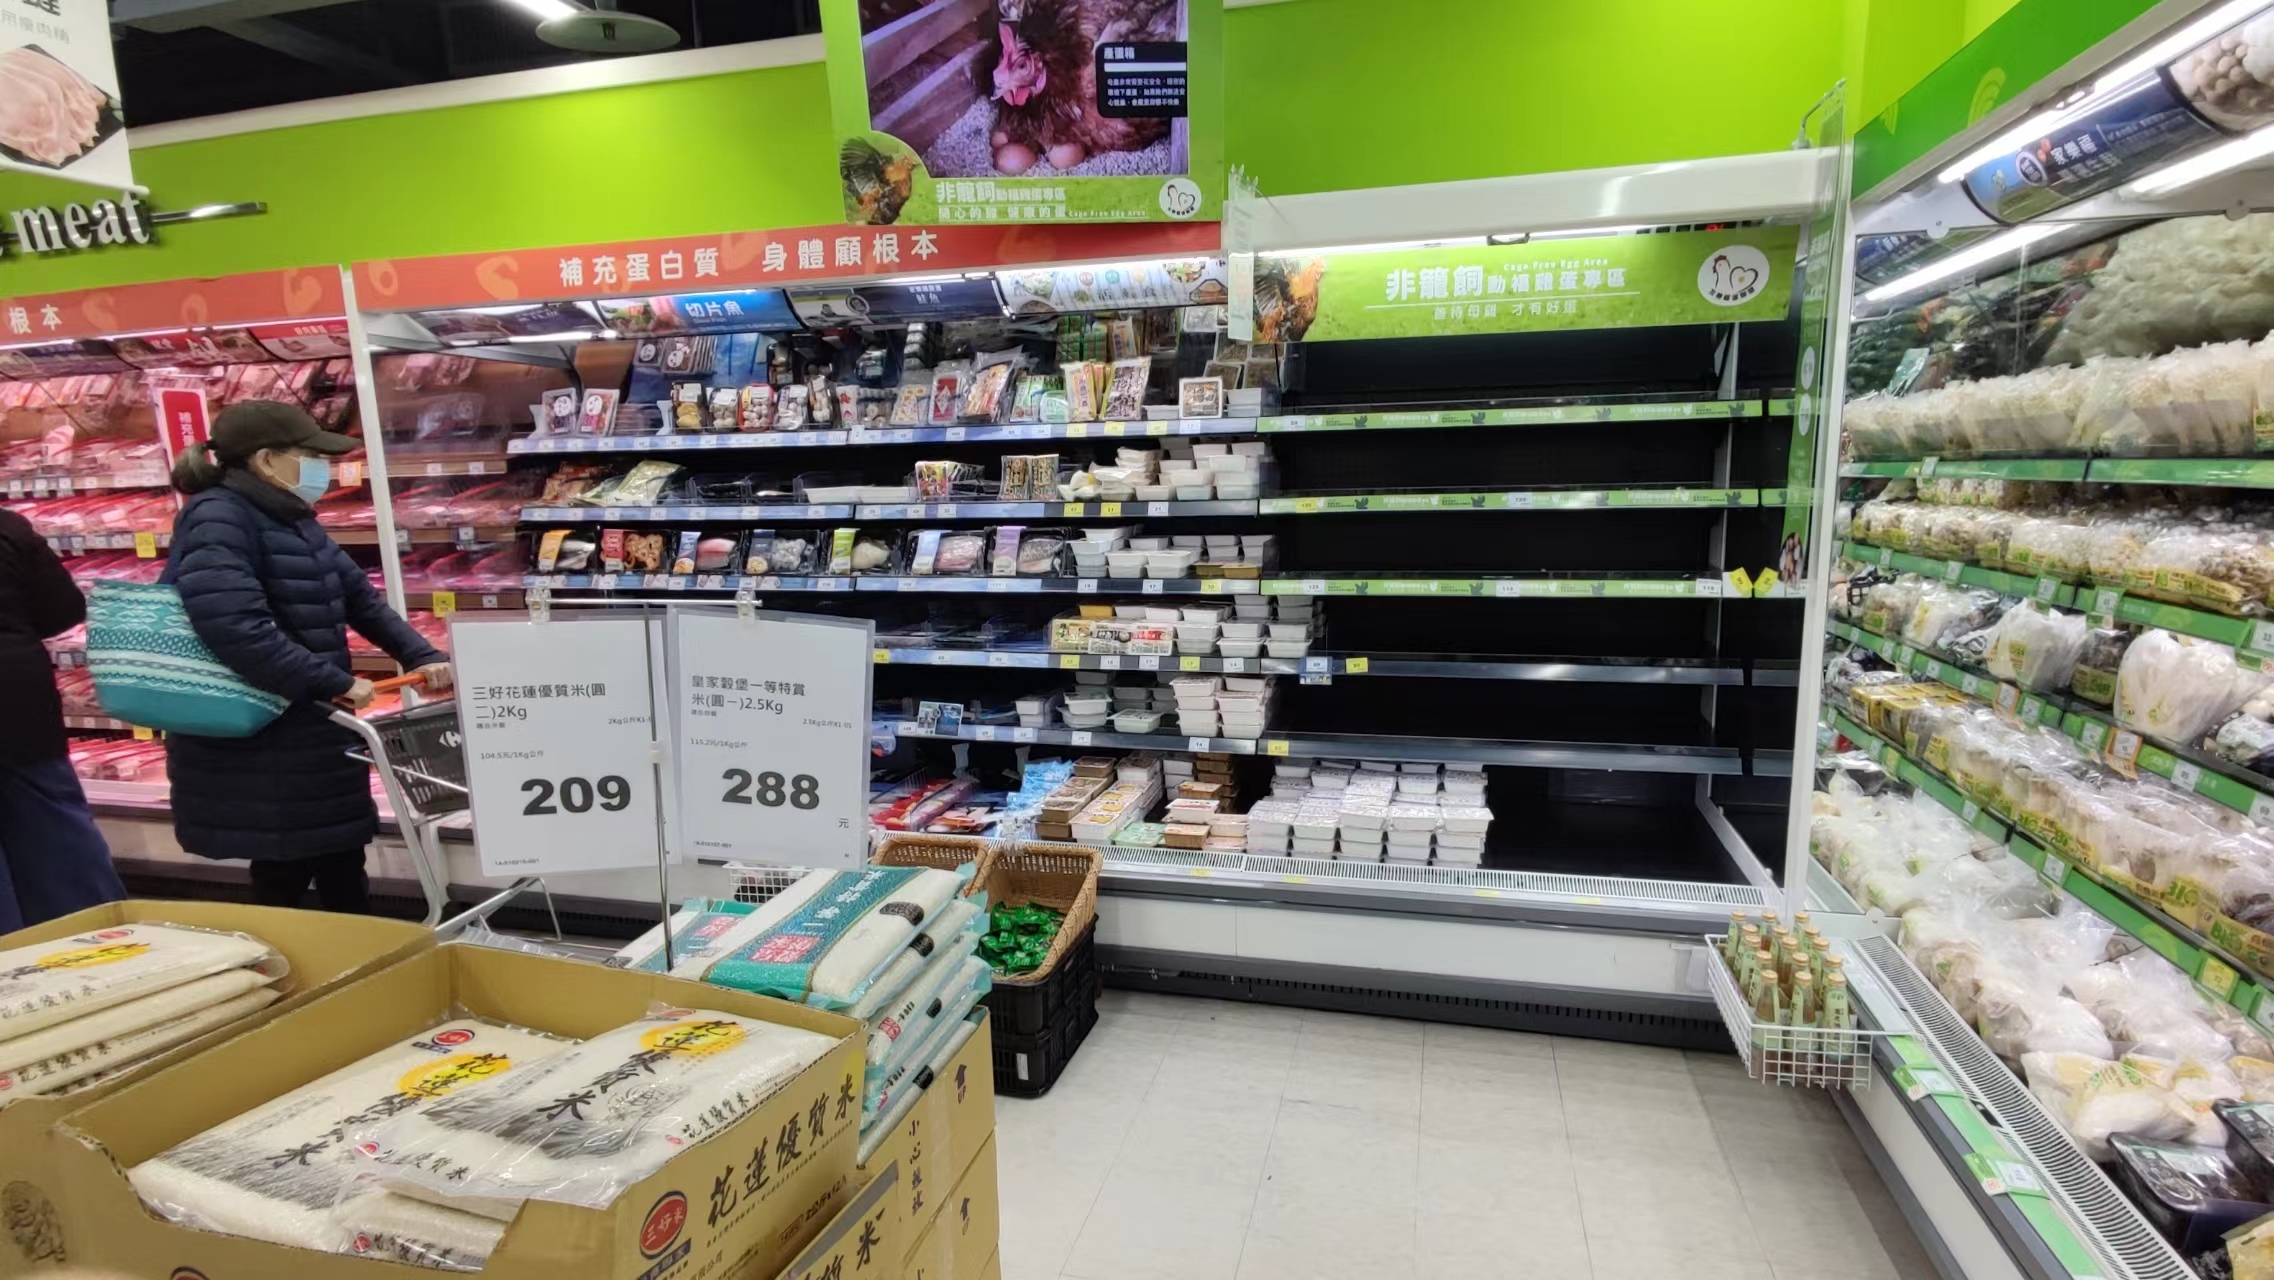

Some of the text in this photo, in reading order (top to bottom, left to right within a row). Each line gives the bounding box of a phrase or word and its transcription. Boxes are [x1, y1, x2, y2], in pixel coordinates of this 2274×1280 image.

[11, 190, 150, 253] meat
[559, 231, 939, 288] 補充蛋白質 身體顧根本
[1503, 257, 1609, 272] Cage Free Egg Area
[8, 303, 63, 335] 根本
[685, 299, 744, 319] 切片魚
[472, 683, 606, 700] 三好花蓮優質米(圓
[692, 675, 806, 697] 皇家穀堡一等特賞
[475, 705, 528, 721] 二)2Kg
[520, 775, 632, 816] 209
[722, 767, 821, 810] 288
[838, 817, 850, 829] 元
[708, 1073, 856, 1229] 花蓮優質米
[644, 1206, 684, 1247] 三好米
